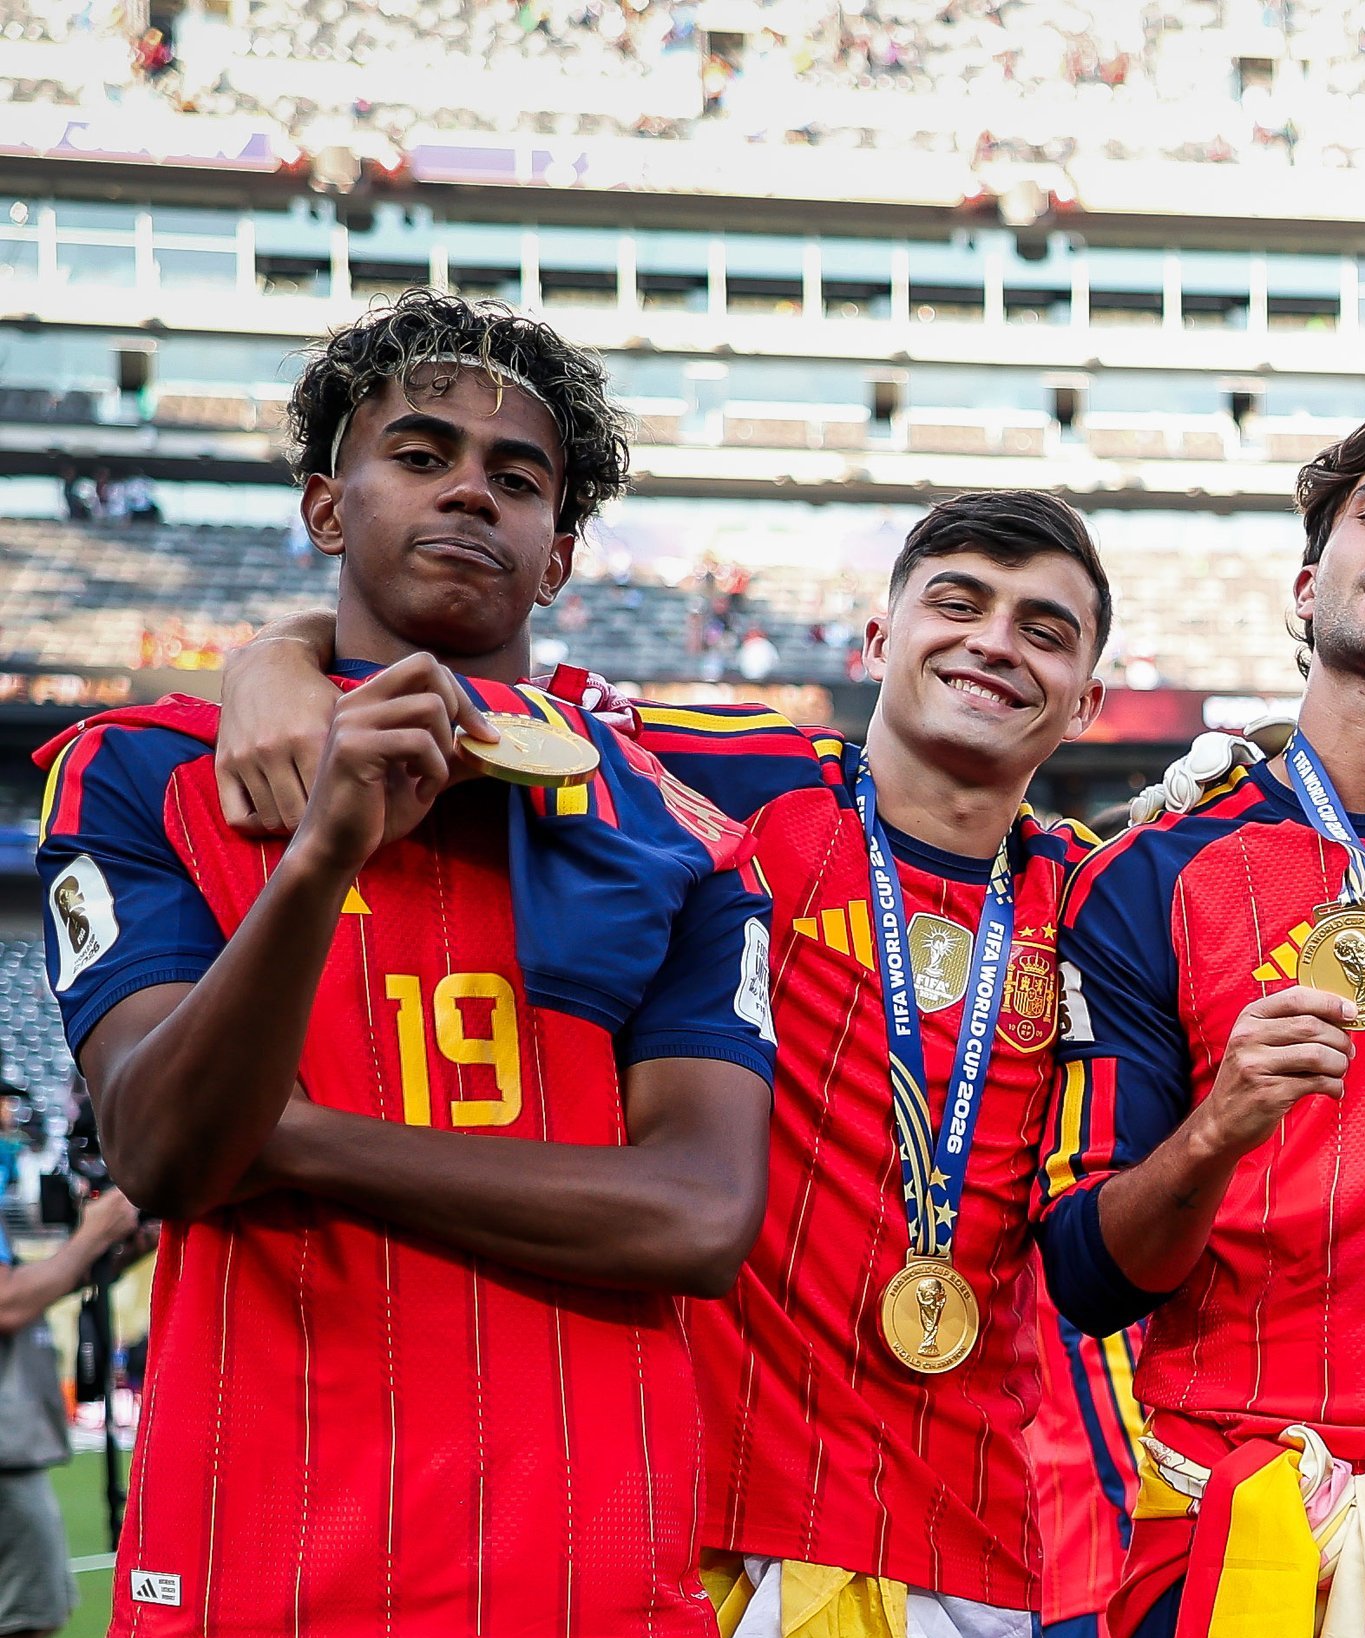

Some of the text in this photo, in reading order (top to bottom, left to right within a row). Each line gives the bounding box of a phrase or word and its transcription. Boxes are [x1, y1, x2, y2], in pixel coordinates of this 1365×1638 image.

[877, 869, 897, 921] CUP
[884, 922, 907, 989] WORLD
[915, 973, 950, 993] FIFA
[894, 992, 912, 1037] FIFA
[945, 919, 1005, 1155] FIFA WORLD CUP 2026
[385, 973, 524, 1128] 19
